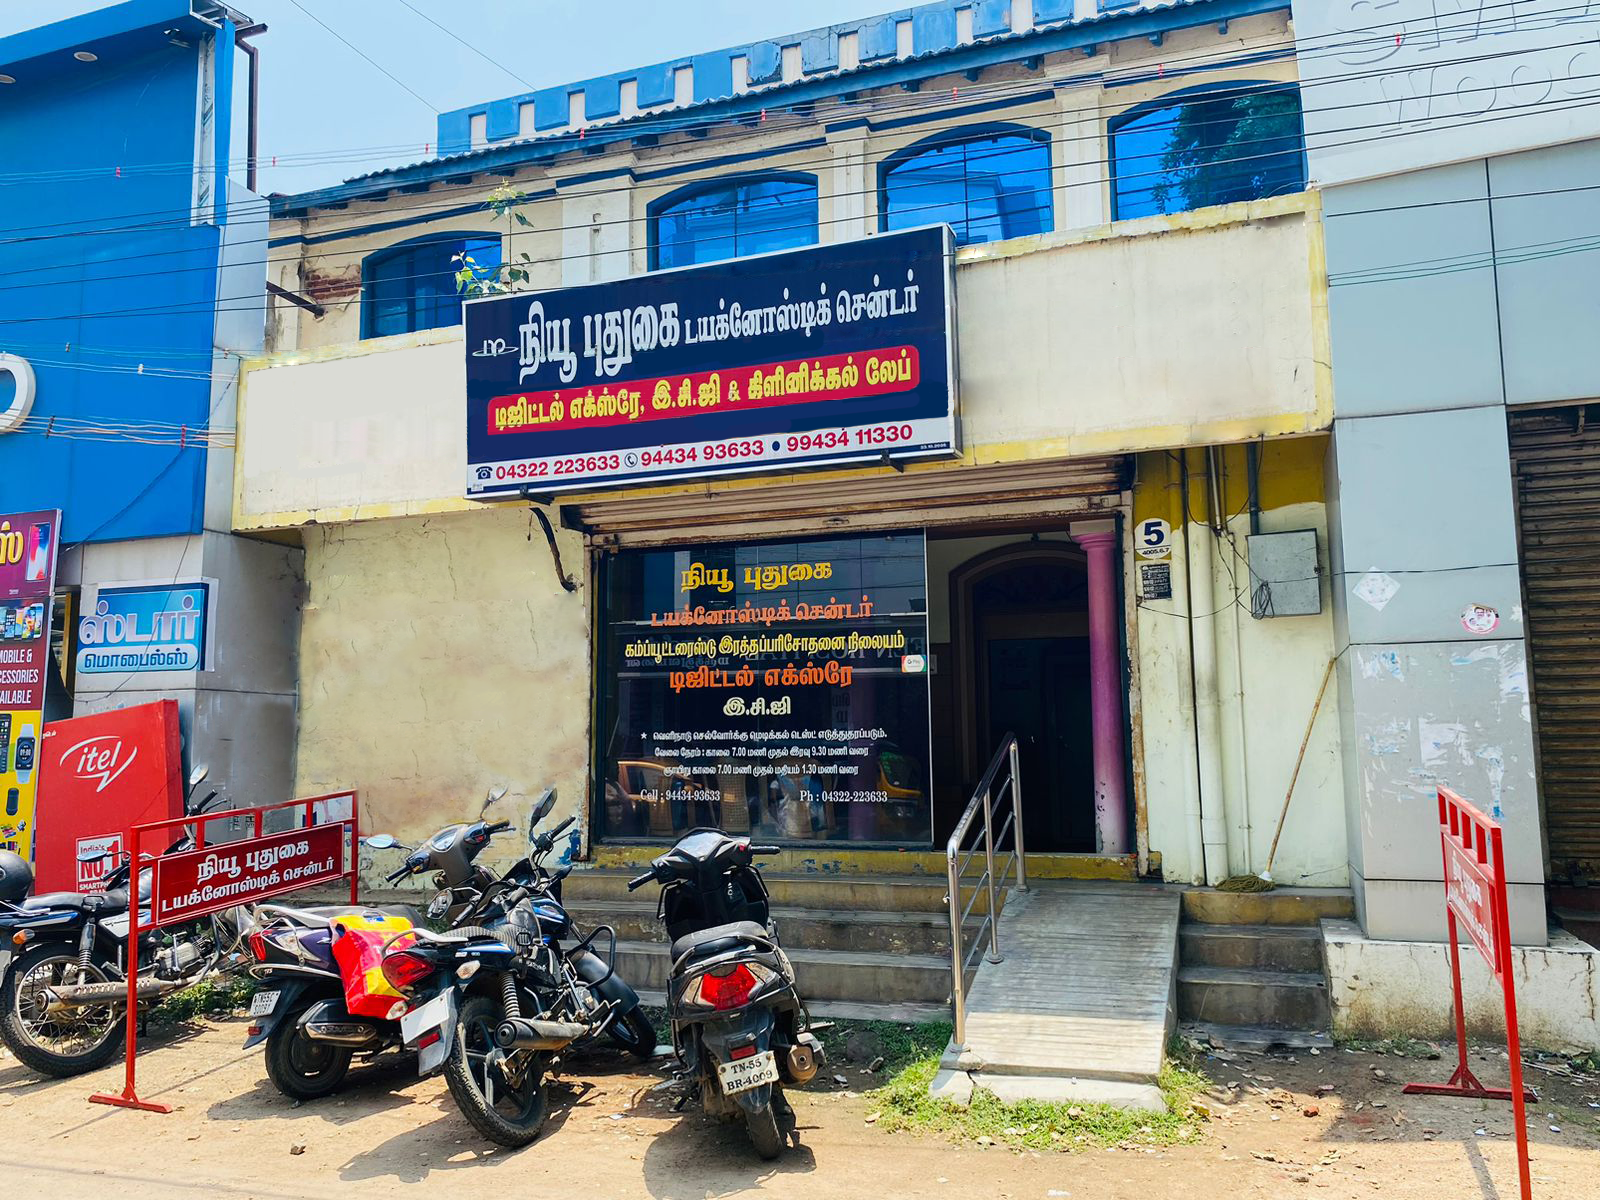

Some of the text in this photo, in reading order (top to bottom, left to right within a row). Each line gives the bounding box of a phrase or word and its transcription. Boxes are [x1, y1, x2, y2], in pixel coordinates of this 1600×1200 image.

[519, 268, 919, 385] நியூ புதுகை டயக்னோஸ்டிக் சென்டர்
[495, 348, 911, 431] டிஜிட்டல் எக்ஸ்ரே, இ.சி.ஜி & கிளினிக்கல் லேப்
[495, 424, 913, 480] 04322 223633 94434 93633 99434 11330
[1143, 521, 1165, 546] 5
[680, 561, 833, 593] நியூ புதுகை
[79, 595, 200, 645] ஸ்டார்
[650, 594, 873, 627] டயக்னோஸ்டிக் சென்டர்
[26, 648, 33, 663] &
[84, 647, 188, 668] மொபைல்ஸ்
[625, 636, 717, 664] கம்ப்யூட்டரைஸ்டு
[718, 632, 846, 659] இரத்தப்பரிசோதனை
[848, 629, 905, 655] நிலையம்
[669, 660, 854, 693] டிஜிட்டல் எக்ஸ்ரே
[0, 690, 32, 704] AILABLE
[722, 695, 791, 717] இ.சி.ஜி
[77, 741, 121, 773] itel
[654, 747, 680, 757] வேலை
[680, 747, 701, 759] நேரம்
[706, 748, 730, 757] காலை
[732, 747, 747, 757] 7.00
[747, 747, 766, 757] மணி
[768, 746, 789, 759] முதல்
[790, 745, 811, 758] இரவு
[811, 746, 827, 756] 9.30
[828, 746, 848, 756] மணி
[848, 746, 869, 757] வரை
[692, 766, 716, 775] காலை
[718, 764, 732, 775] 7.00
[732, 764, 752, 775] மணி
[752, 764, 773, 777] முதல்
[774, 764, 800, 776] மதியம்
[801, 764, 816, 775] 1.30
[818, 764, 837, 775] மணி
[838, 765, 859, 775] வரை
[640, 789, 658, 801] Cell
[665, 789, 720, 802] 94434-93633
[800, 790, 813, 802] Ph
[821, 790, 888, 803] 04322-223633
[197, 840, 309, 885] நியூ புதுகை
[161, 856, 334, 913] டயக்னோஸ்டிக் சென்டர்
[726, 1070, 773, 1090] BR-4009
[731, 1058, 762, 1074] TN-55
